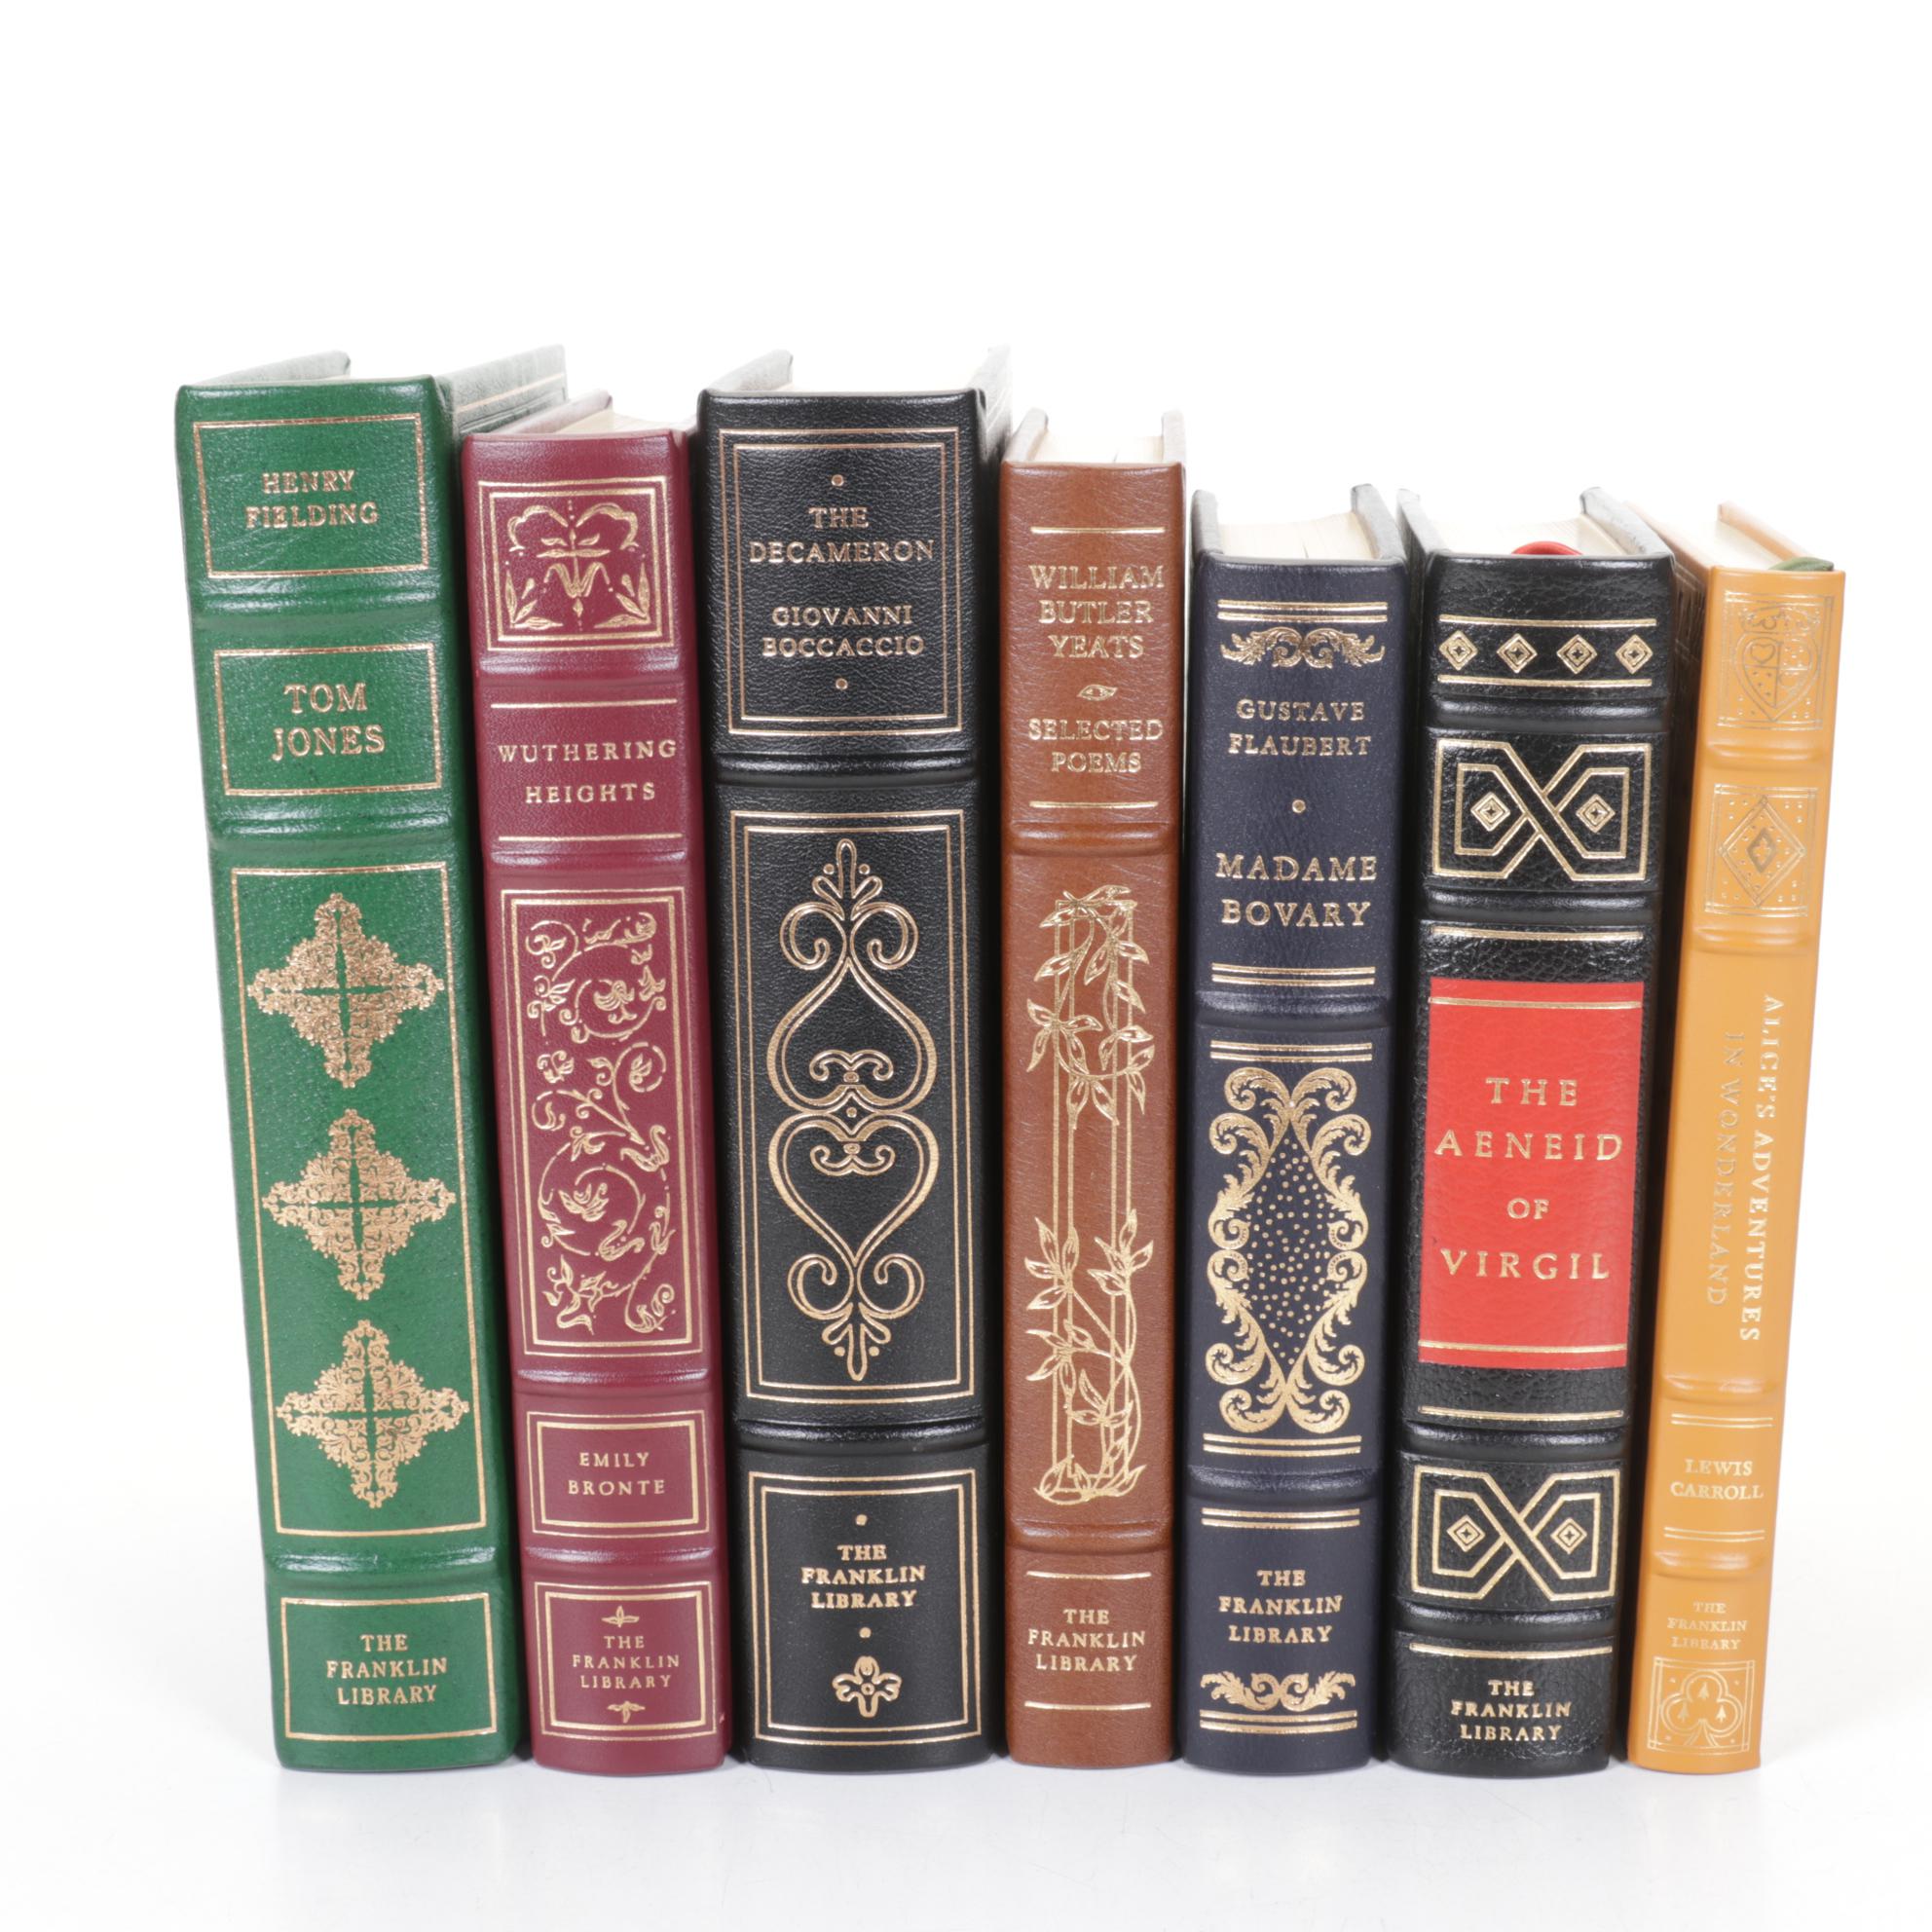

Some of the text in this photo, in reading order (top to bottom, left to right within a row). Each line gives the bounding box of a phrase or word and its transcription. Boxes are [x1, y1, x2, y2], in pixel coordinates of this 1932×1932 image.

[263, 470, 355, 494] HENRY
[245, 502, 380, 529] FIELDING
[808, 506, 869, 530] THE
[749, 539, 934, 564] DECAMERON
[1029, 565, 1164, 590] WILLIAM
[771, 606, 913, 628] GIOVANNI
[1040, 599, 1153, 624] BUTLER
[762, 635, 924, 658] BOCCACCIO
[1048, 634, 1144, 658] YEATS
[284, 684, 367, 714] TOM
[1237, 699, 1364, 723] GUSTAVE
[1028, 719, 1164, 742] SELECTED
[271, 724, 386, 762] JONES
[498, 739, 677, 763] WUTHERING
[1229, 734, 1372, 757] FLAUBERT
[1051, 752, 1141, 773] POEMS
[526, 783, 655, 803] HEIGHTS
[1215, 854, 1377, 880] MADAME
[1222, 900, 1371, 927] BOVARY
[1486, 1077, 1579, 1106] THE
[1432, 1129, 1622, 1160] AENEID
[1707, 1032, 1745, 1306] IN WONDERLAND
[1740, 994, 1784, 1342] ALICE'S ADVENTURES
[1507, 1199, 1548, 1219] OF
[1440, 1249, 1611, 1281] VIRGIL
[579, 1452, 649, 1468] EMILY
[1685, 1459, 1753, 1477] LEWIS
[568, 1480, 665, 1497] BRONTE
[1669, 1481, 1764, 1501] CARROLL
[837, 1544, 887, 1562] THE
[801, 1566, 926, 1585] FRANKLIN
[1256, 1569, 1306, 1587] THE
[811, 1590, 916, 1610] LIBRARY
[1218, 1595, 1343, 1616] FRANKLIN
[1692, 1600, 1727, 1615] THE
[1063, 1609, 1109, 1625] THE
[1666, 1617, 1747, 1633] FRANKLIN
[360, 1634, 407, 1652] THE
[604, 1635, 645, 1650] THE
[1027, 1629, 1145, 1649] FRANKLIN
[1228, 1624, 1332, 1645] LIBRARY
[1670, 1637, 1741, 1651] LIBRARY
[326, 1658, 447, 1679] FRANKLIN
[573, 1653, 680, 1669] FRANKLIN
[1036, 1653, 1138, 1672] LIBRARY
[580, 1675, 671, 1690] LIBRARY
[1488, 1680, 1535, 1697] THE
[337, 1685, 437, 1706] LIBRARY
[1450, 1701, 1572, 1719] FRANKLIN
[1459, 1724, 1562, 1742] LIBRARY
